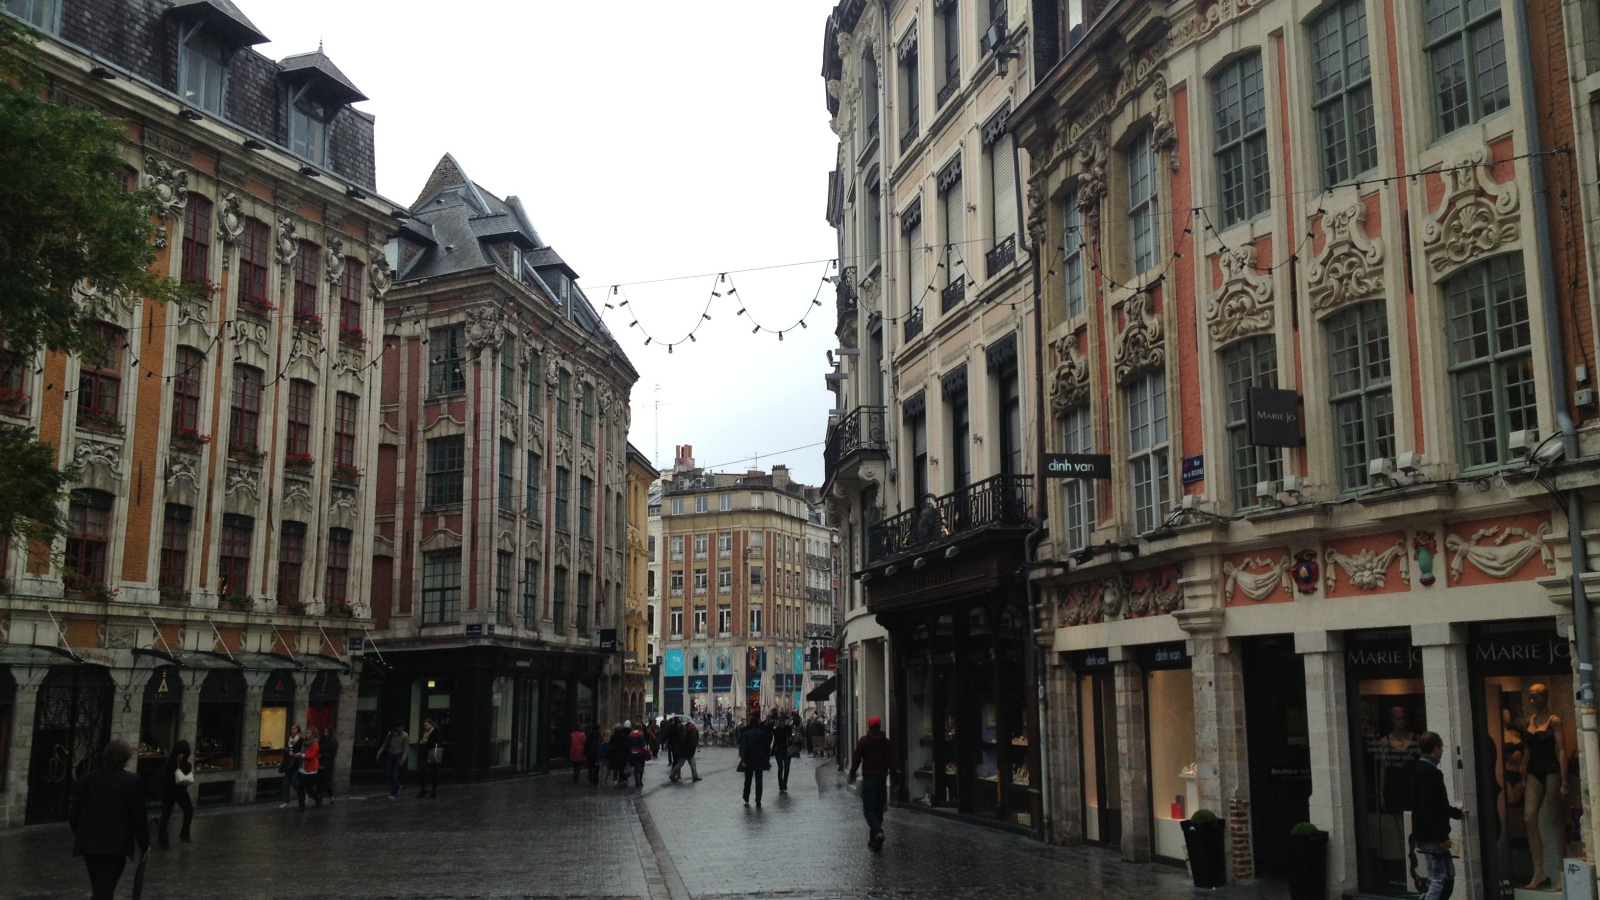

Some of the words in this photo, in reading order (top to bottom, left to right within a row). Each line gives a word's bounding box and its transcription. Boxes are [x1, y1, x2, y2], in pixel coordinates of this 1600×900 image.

[1257, 410, 1285, 420] MARIE
[1286, 412, 1296, 423] JO
[1048, 458, 1072, 472] dinh
[1074, 463, 1095, 472] van
[1156, 647, 1169, 662] dinh
[1170, 651, 1182, 661] van
[1347, 649, 1404, 665] MARIE
[1476, 642, 1542, 661] MARIE
[1548, 639, 1571, 665] JO
